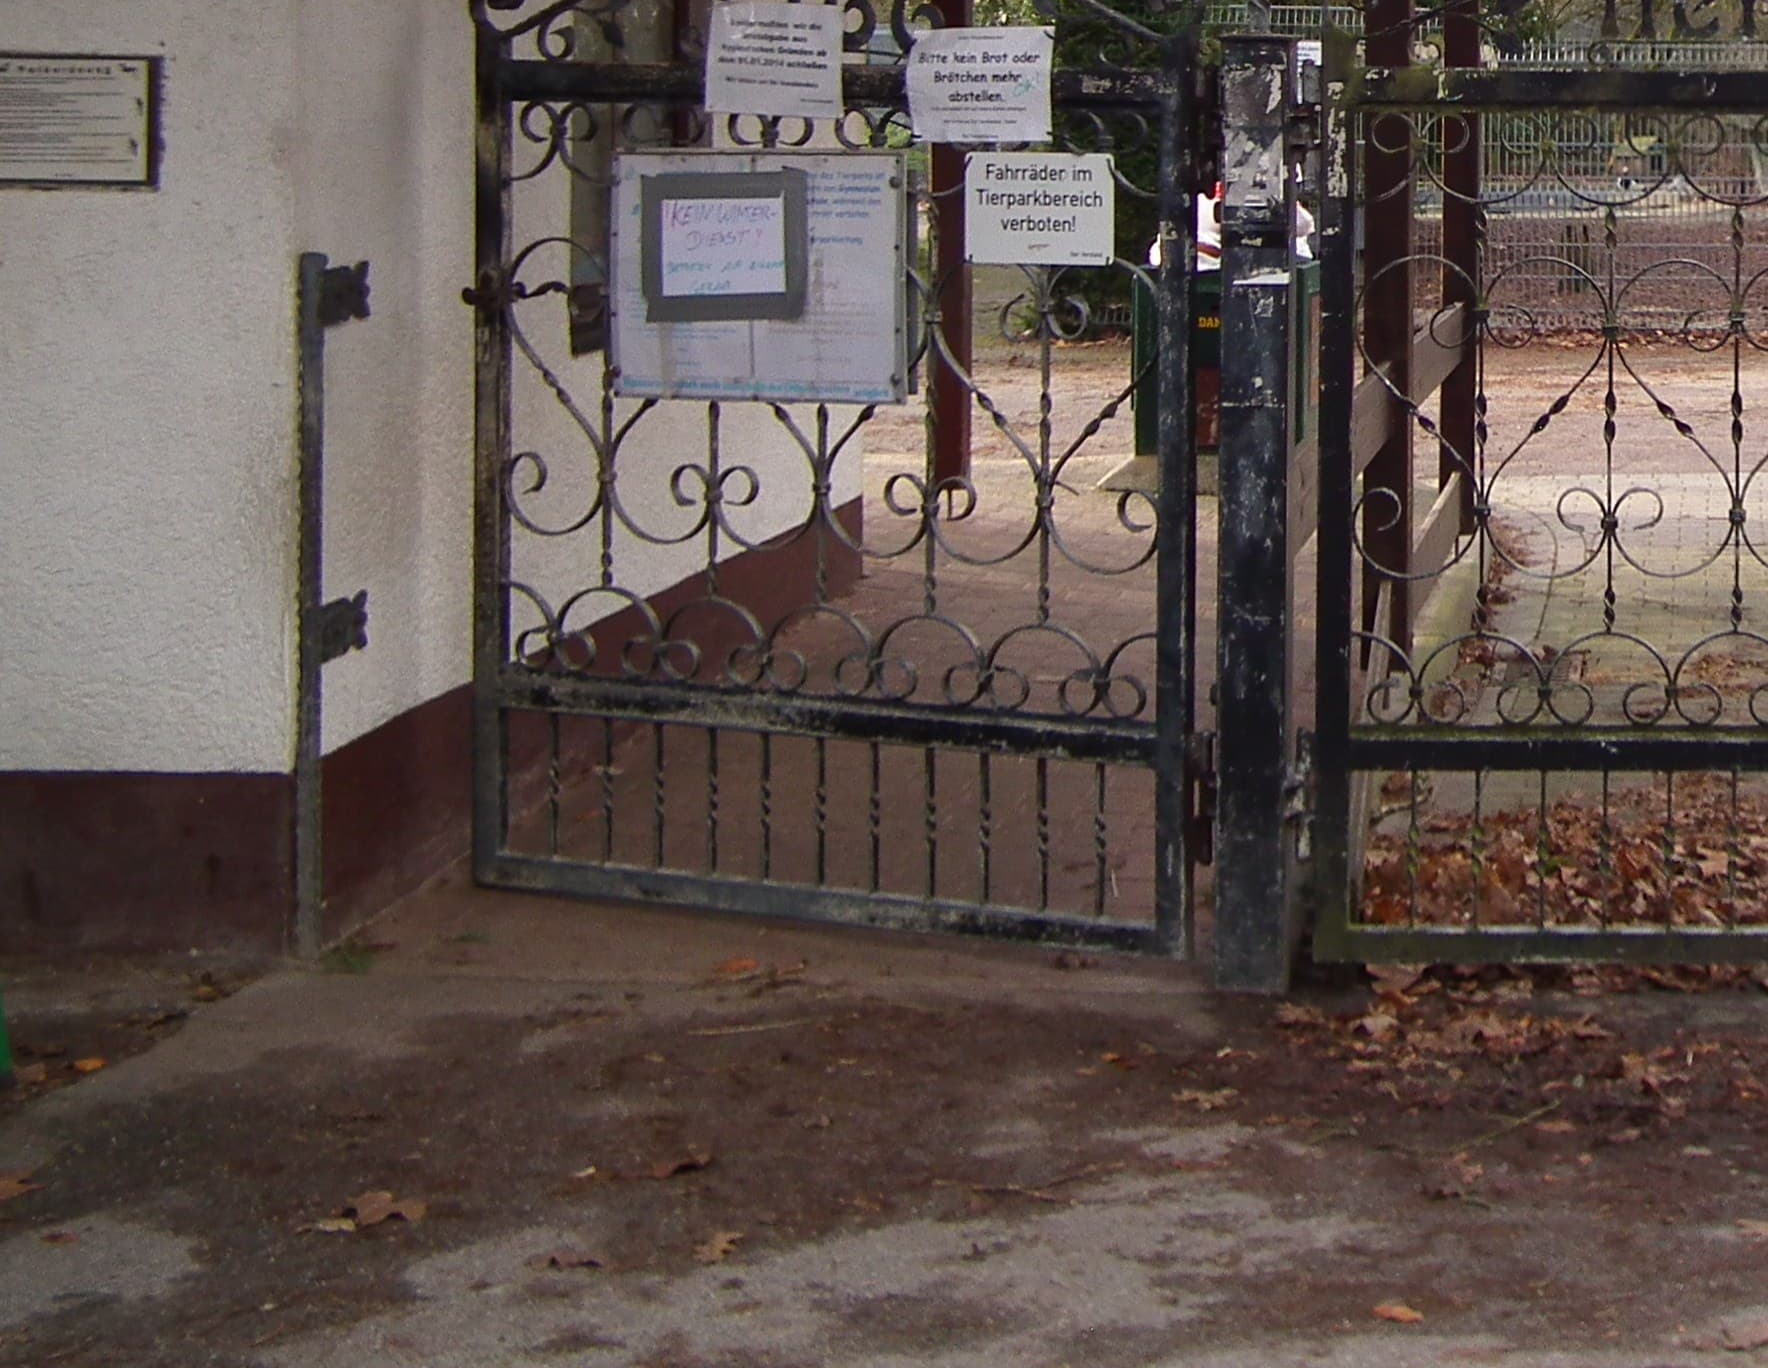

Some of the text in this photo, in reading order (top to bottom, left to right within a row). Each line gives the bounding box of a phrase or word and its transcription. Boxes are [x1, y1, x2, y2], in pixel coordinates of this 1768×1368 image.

[918, 51, 1041, 64] Bitte kein Brot oder
[934, 71, 1022, 83] Brötchen mehr
[985, 163, 1093, 182] Fahrräder im
[976, 188, 1104, 210] Tierparkbereich
[1000, 215, 1077, 233] verboten!
